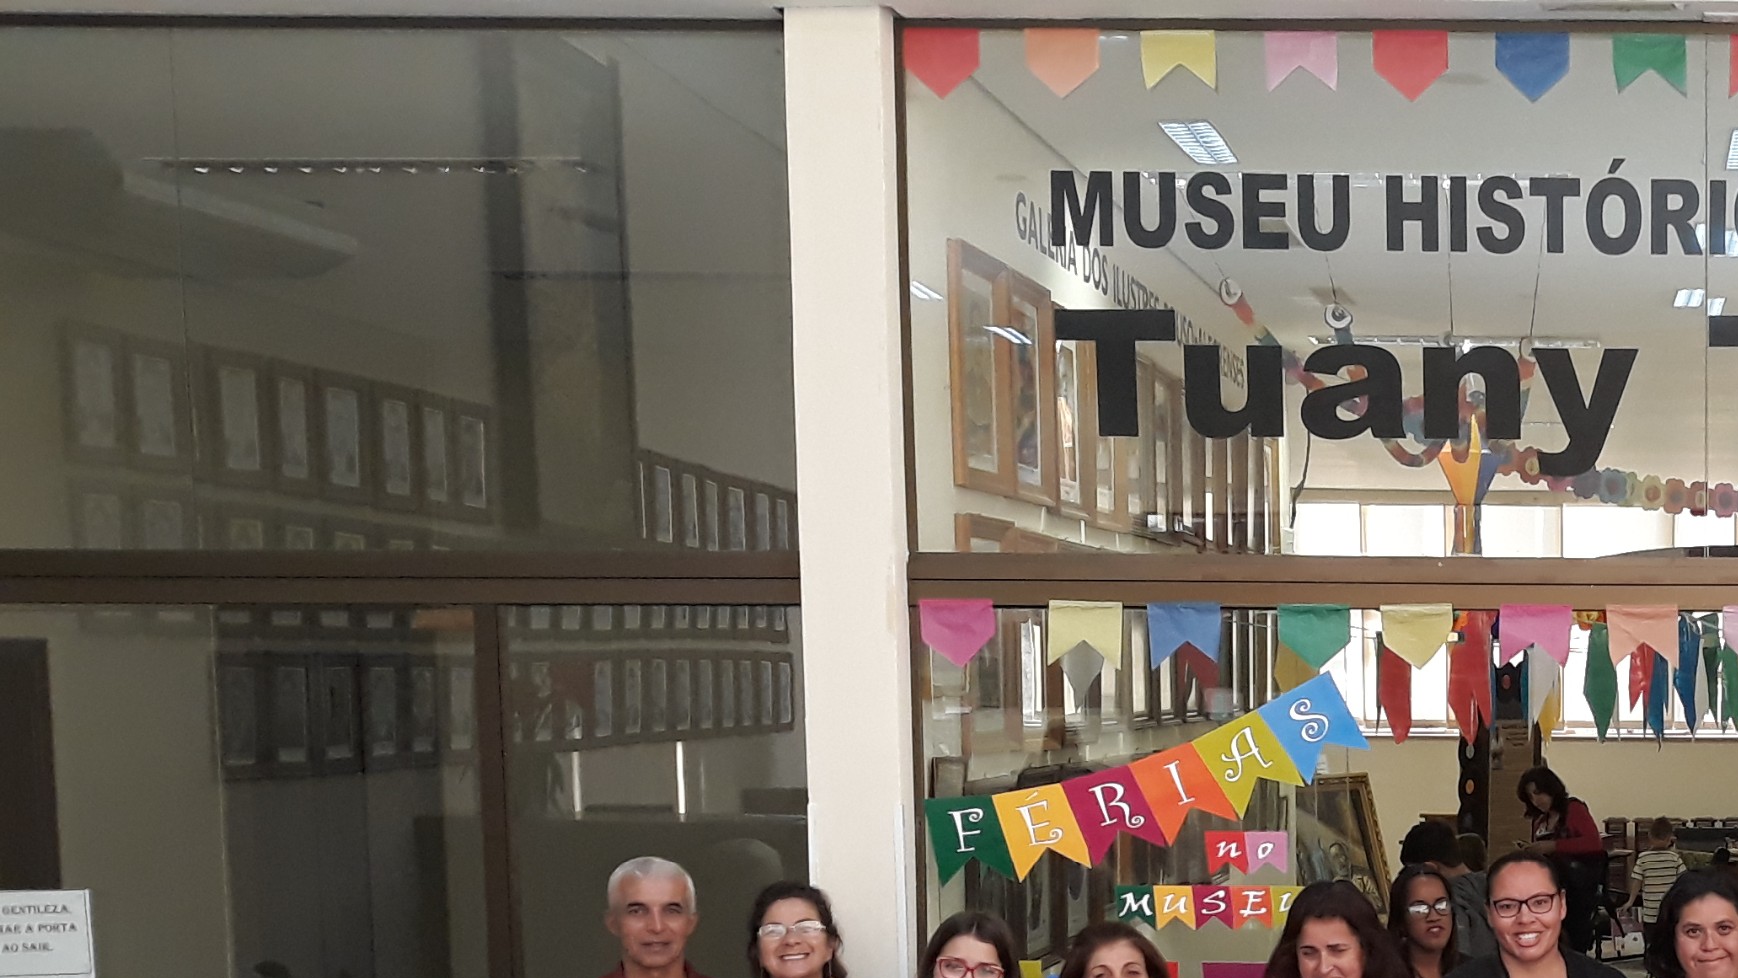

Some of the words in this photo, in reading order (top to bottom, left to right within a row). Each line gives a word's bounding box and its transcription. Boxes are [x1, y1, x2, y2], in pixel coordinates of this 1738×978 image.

[1050, 169, 1351, 252] MUSEU
[1054, 308, 1638, 478] Tuany
[947, 697, 1330, 853] FÉRIAS
[1215, 840, 1275, 860] no
